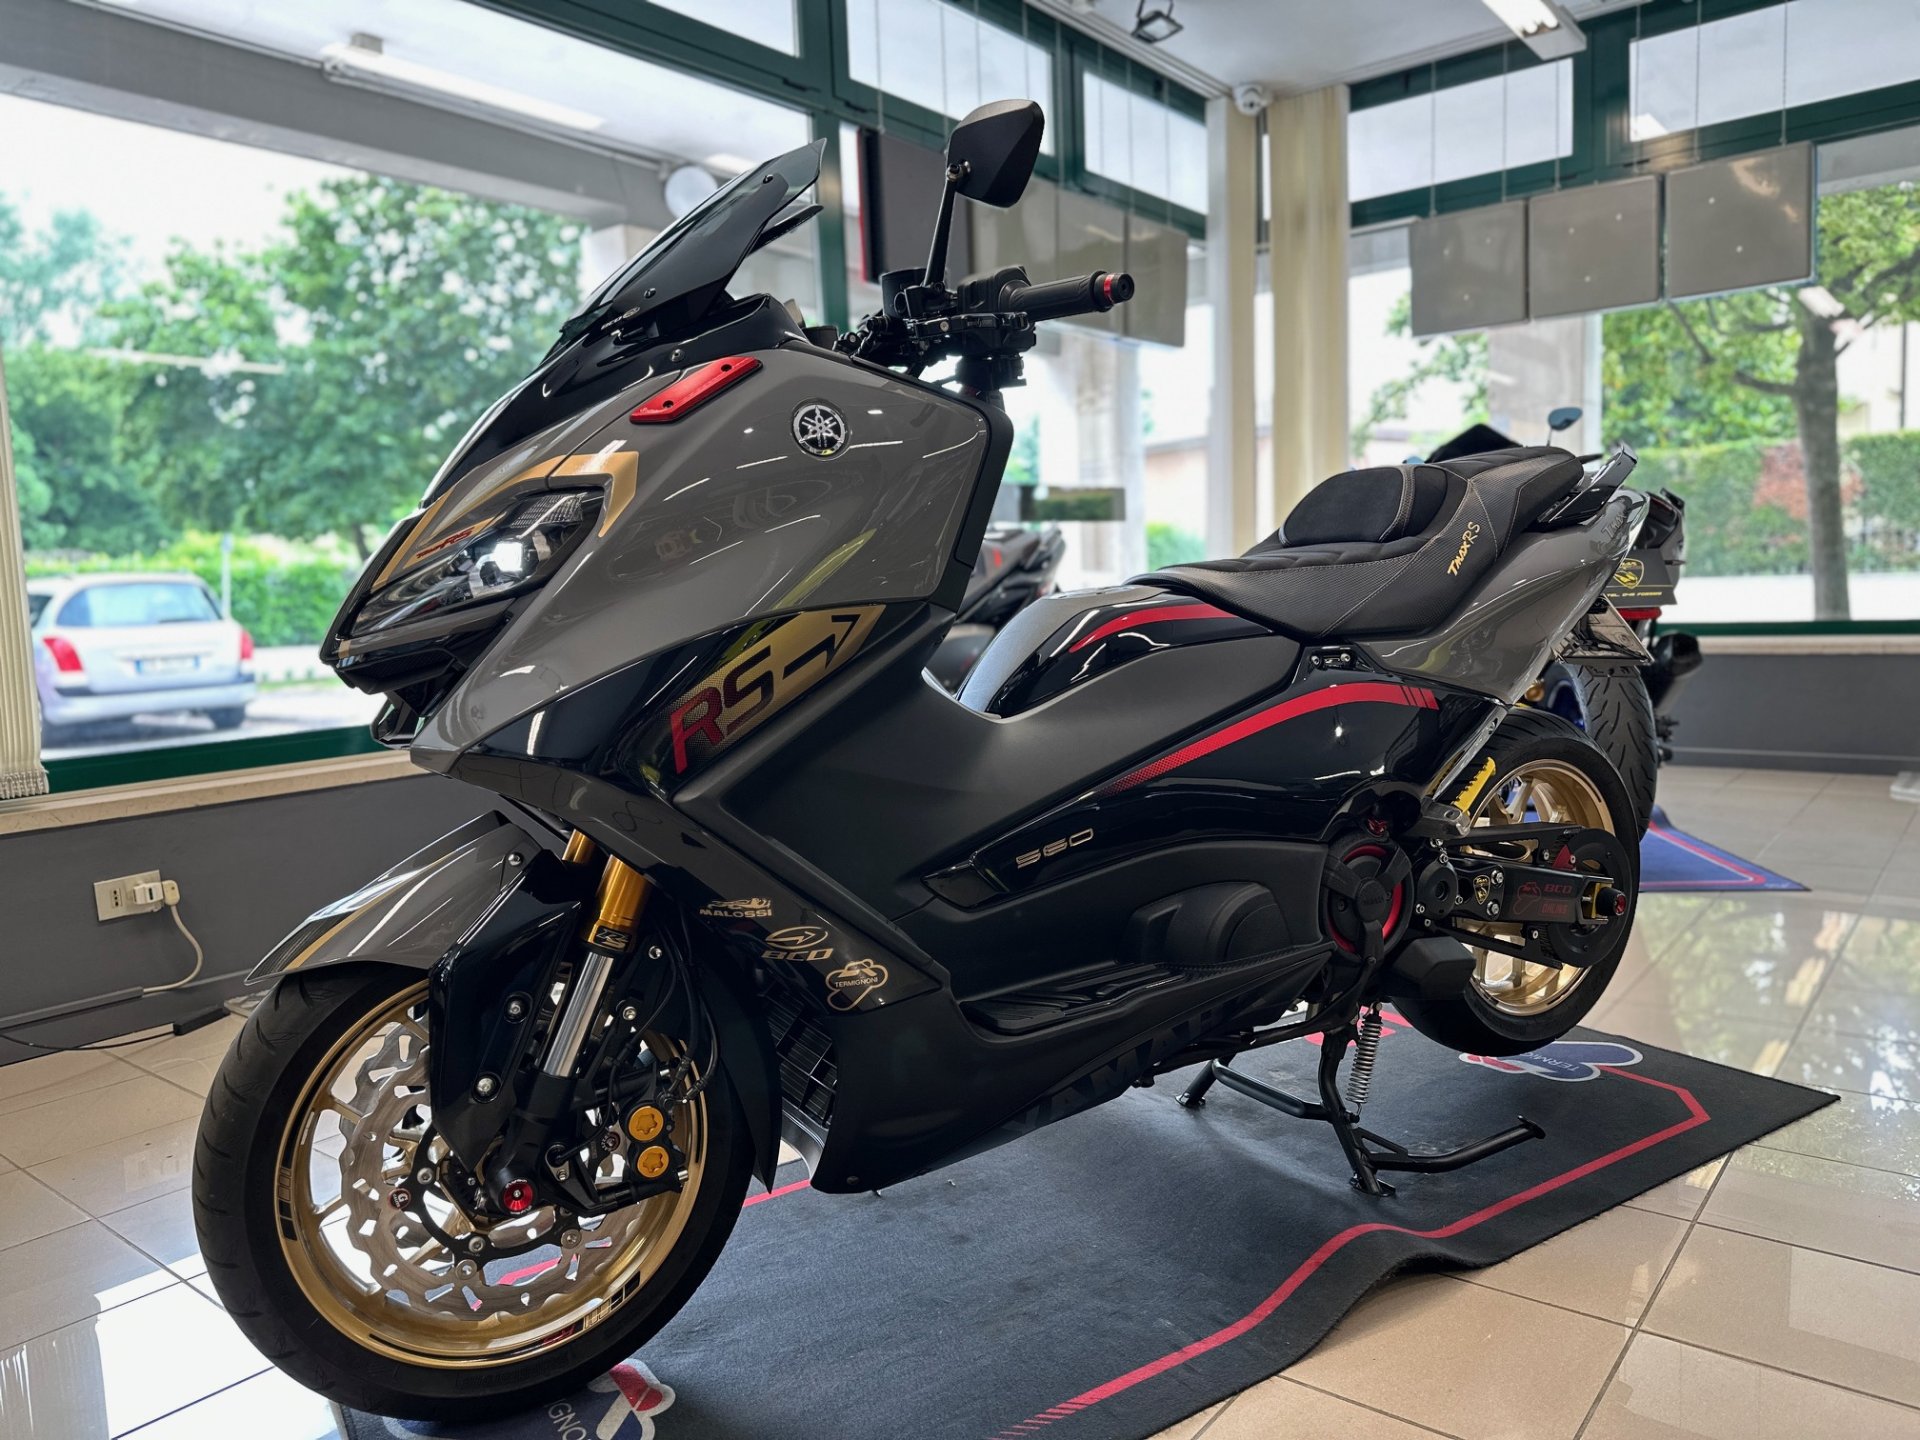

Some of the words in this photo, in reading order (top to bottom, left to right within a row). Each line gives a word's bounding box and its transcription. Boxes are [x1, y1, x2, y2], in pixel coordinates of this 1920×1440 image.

[670, 645, 774, 774] RS
[1016, 827, 1094, 870] 560
[699, 908, 773, 918] MALOSSI
[761, 948, 834, 962] BCO
[834, 977, 879, 989] TERMIGNONI
